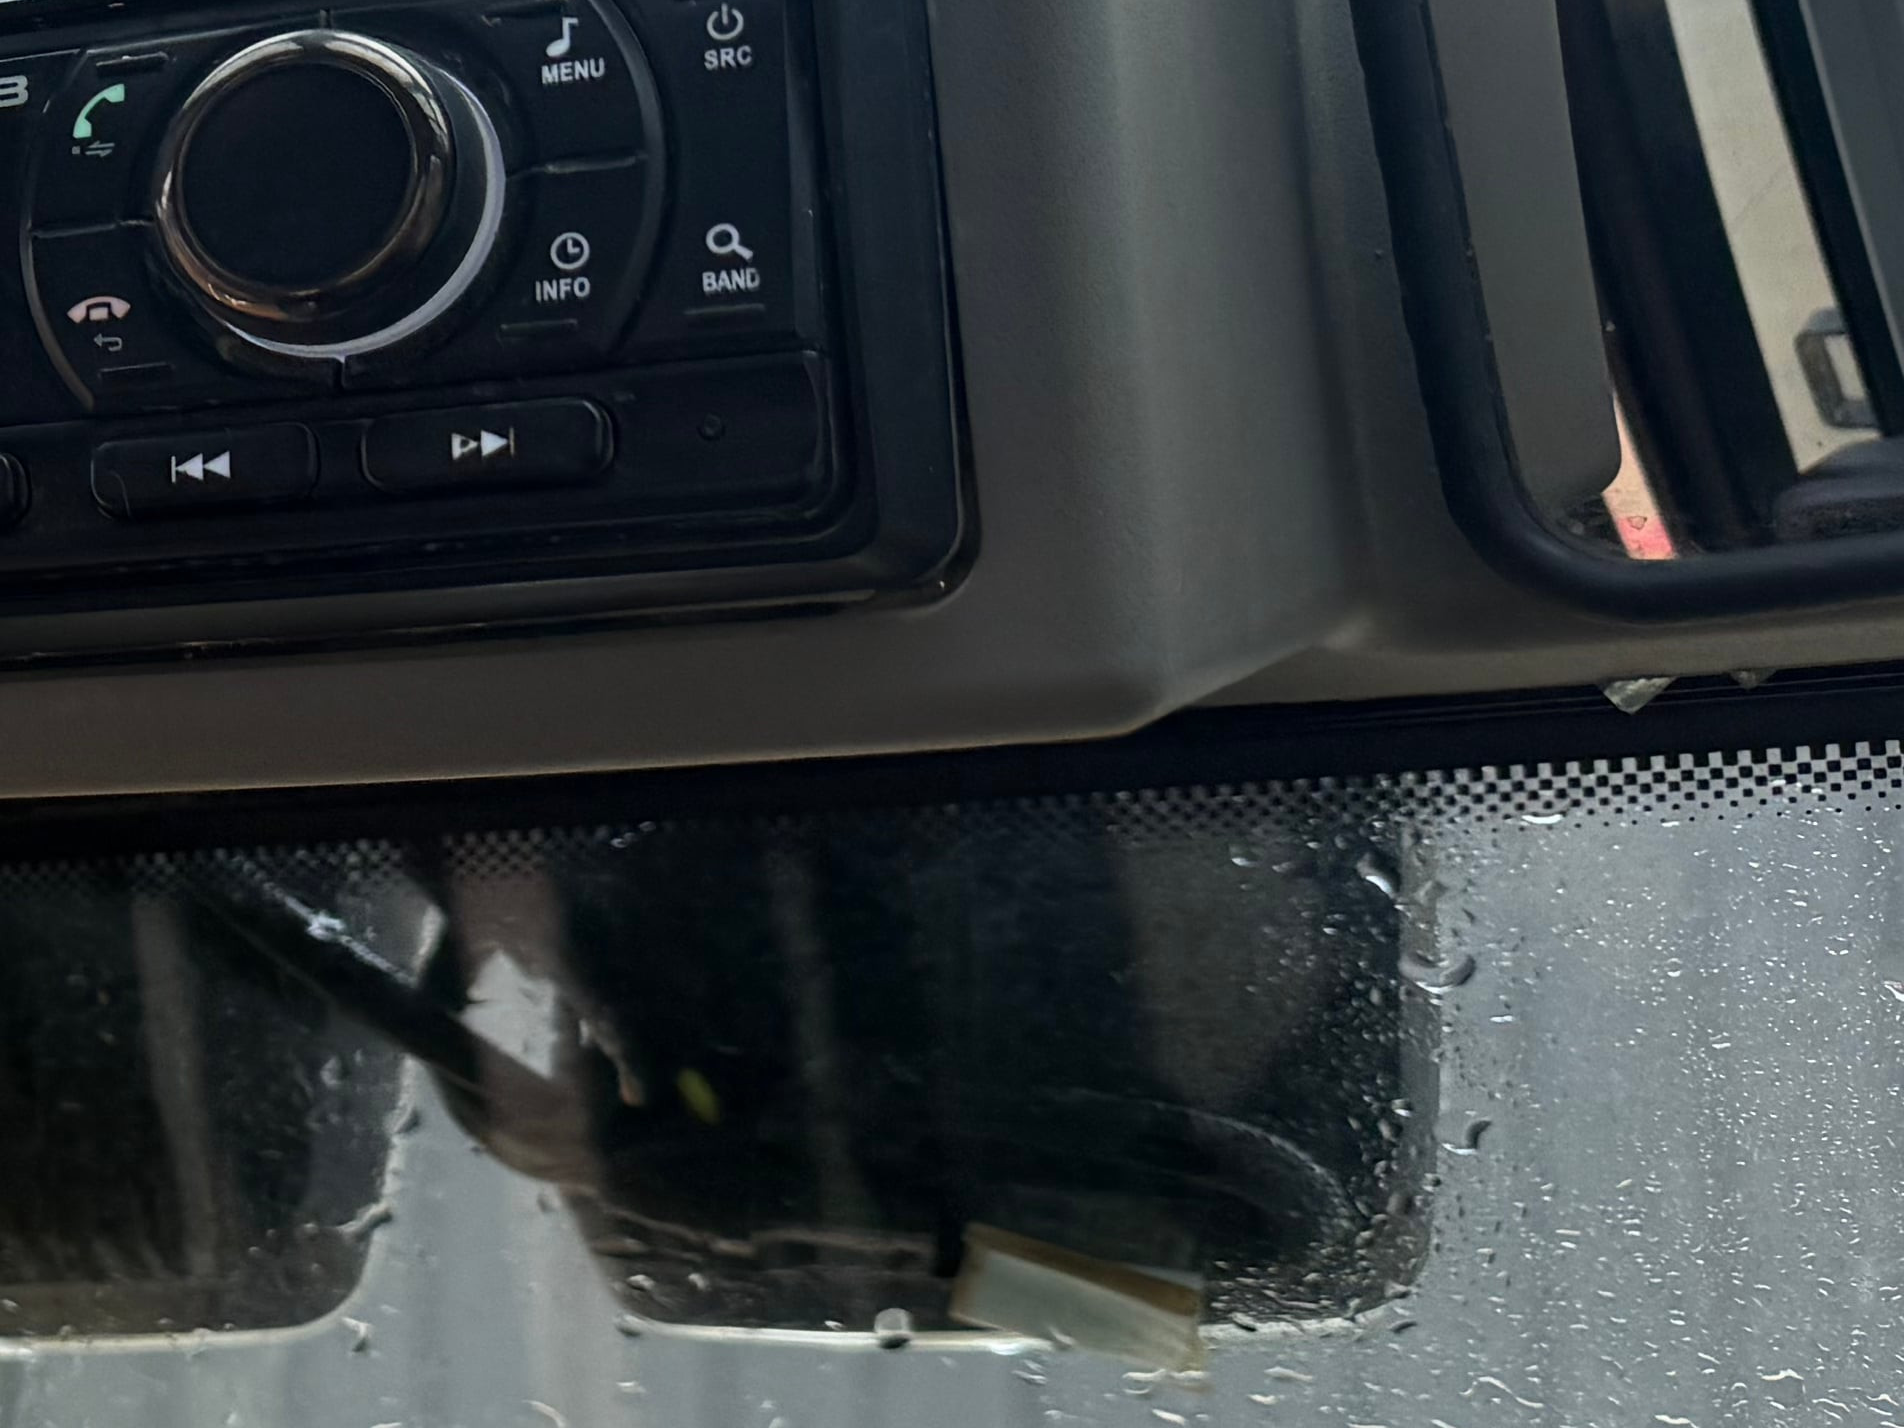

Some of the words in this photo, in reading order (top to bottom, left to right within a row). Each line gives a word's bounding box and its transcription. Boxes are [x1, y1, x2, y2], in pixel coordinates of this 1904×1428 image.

[704, 45, 752, 70] SRC
[541, 57, 605, 84] MENU
[535, 276, 591, 302] INFO
[702, 267, 760, 292] BAND
